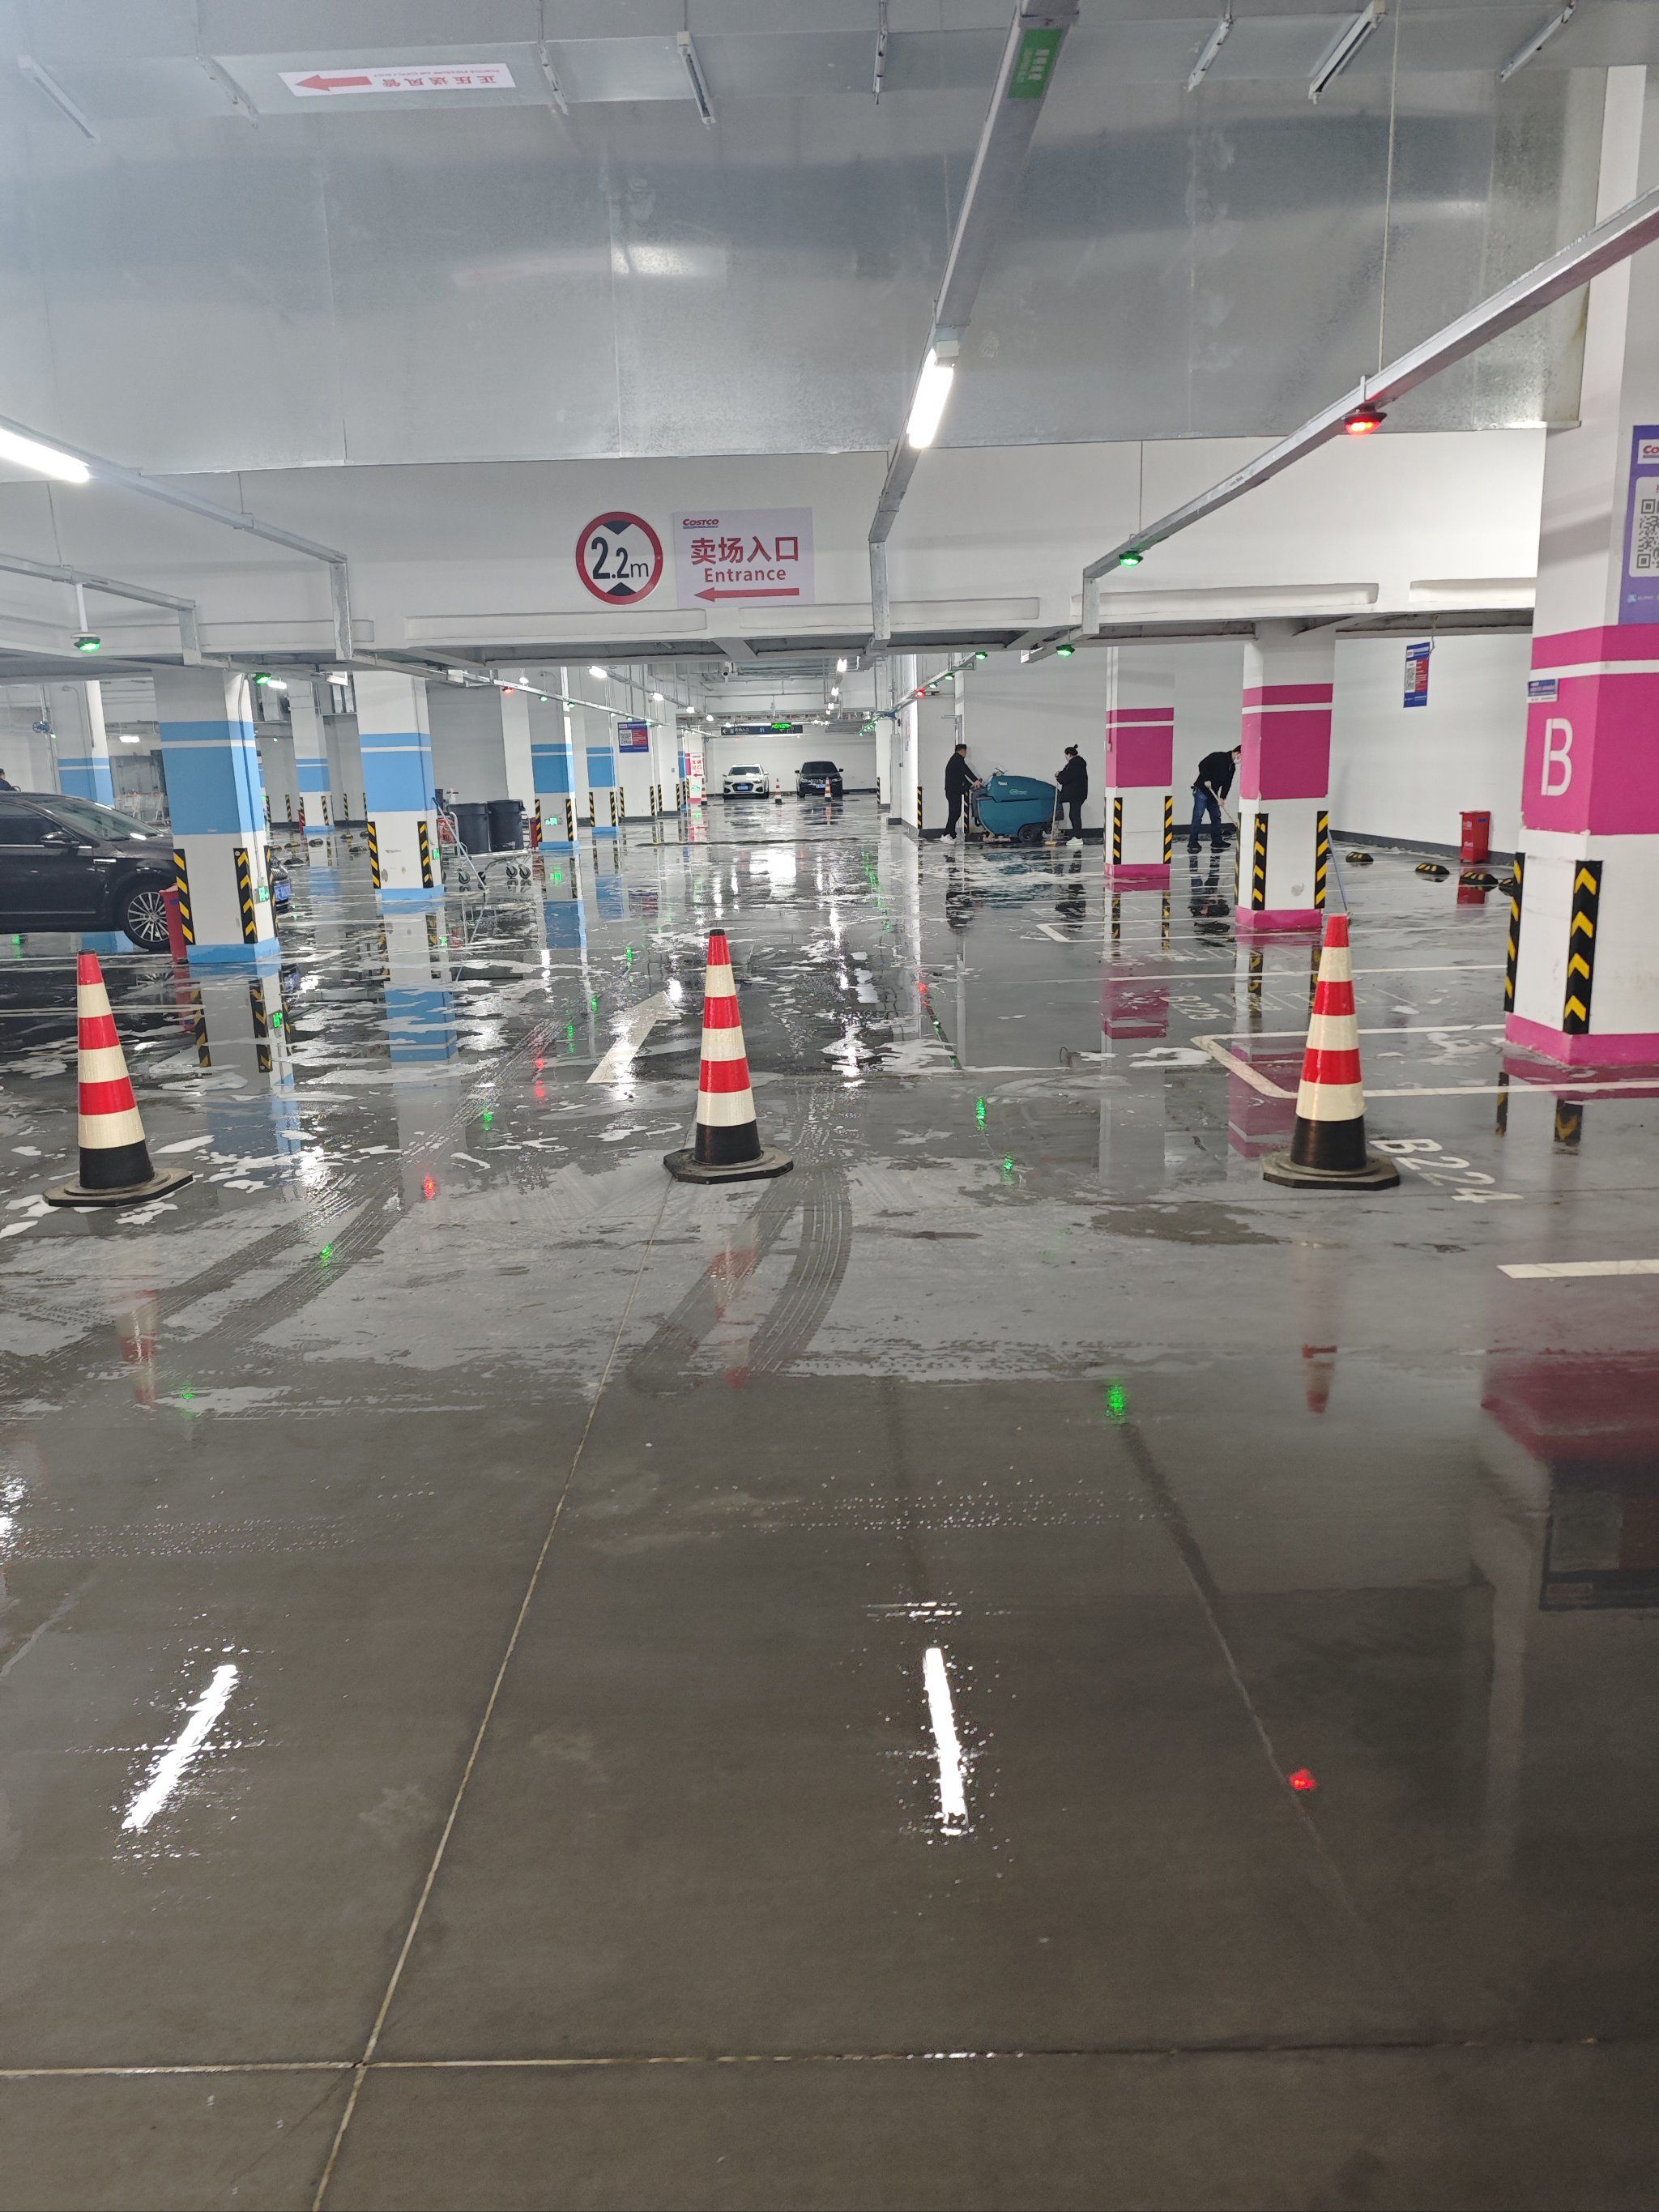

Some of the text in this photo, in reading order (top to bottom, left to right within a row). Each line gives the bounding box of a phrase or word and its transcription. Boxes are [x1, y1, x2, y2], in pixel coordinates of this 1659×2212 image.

[382, 75, 496, 87] 正压送风管
[682, 518, 719, 526] COSTCO
[591, 536, 649, 579] 2.2m
[690, 536, 799, 565] 卖场入口
[704, 568, 787, 582] Entrance
[1541, 718, 1573, 796] B
[1159, 995, 1231, 1020] B225
[1368, 1138, 1524, 1204] B224
